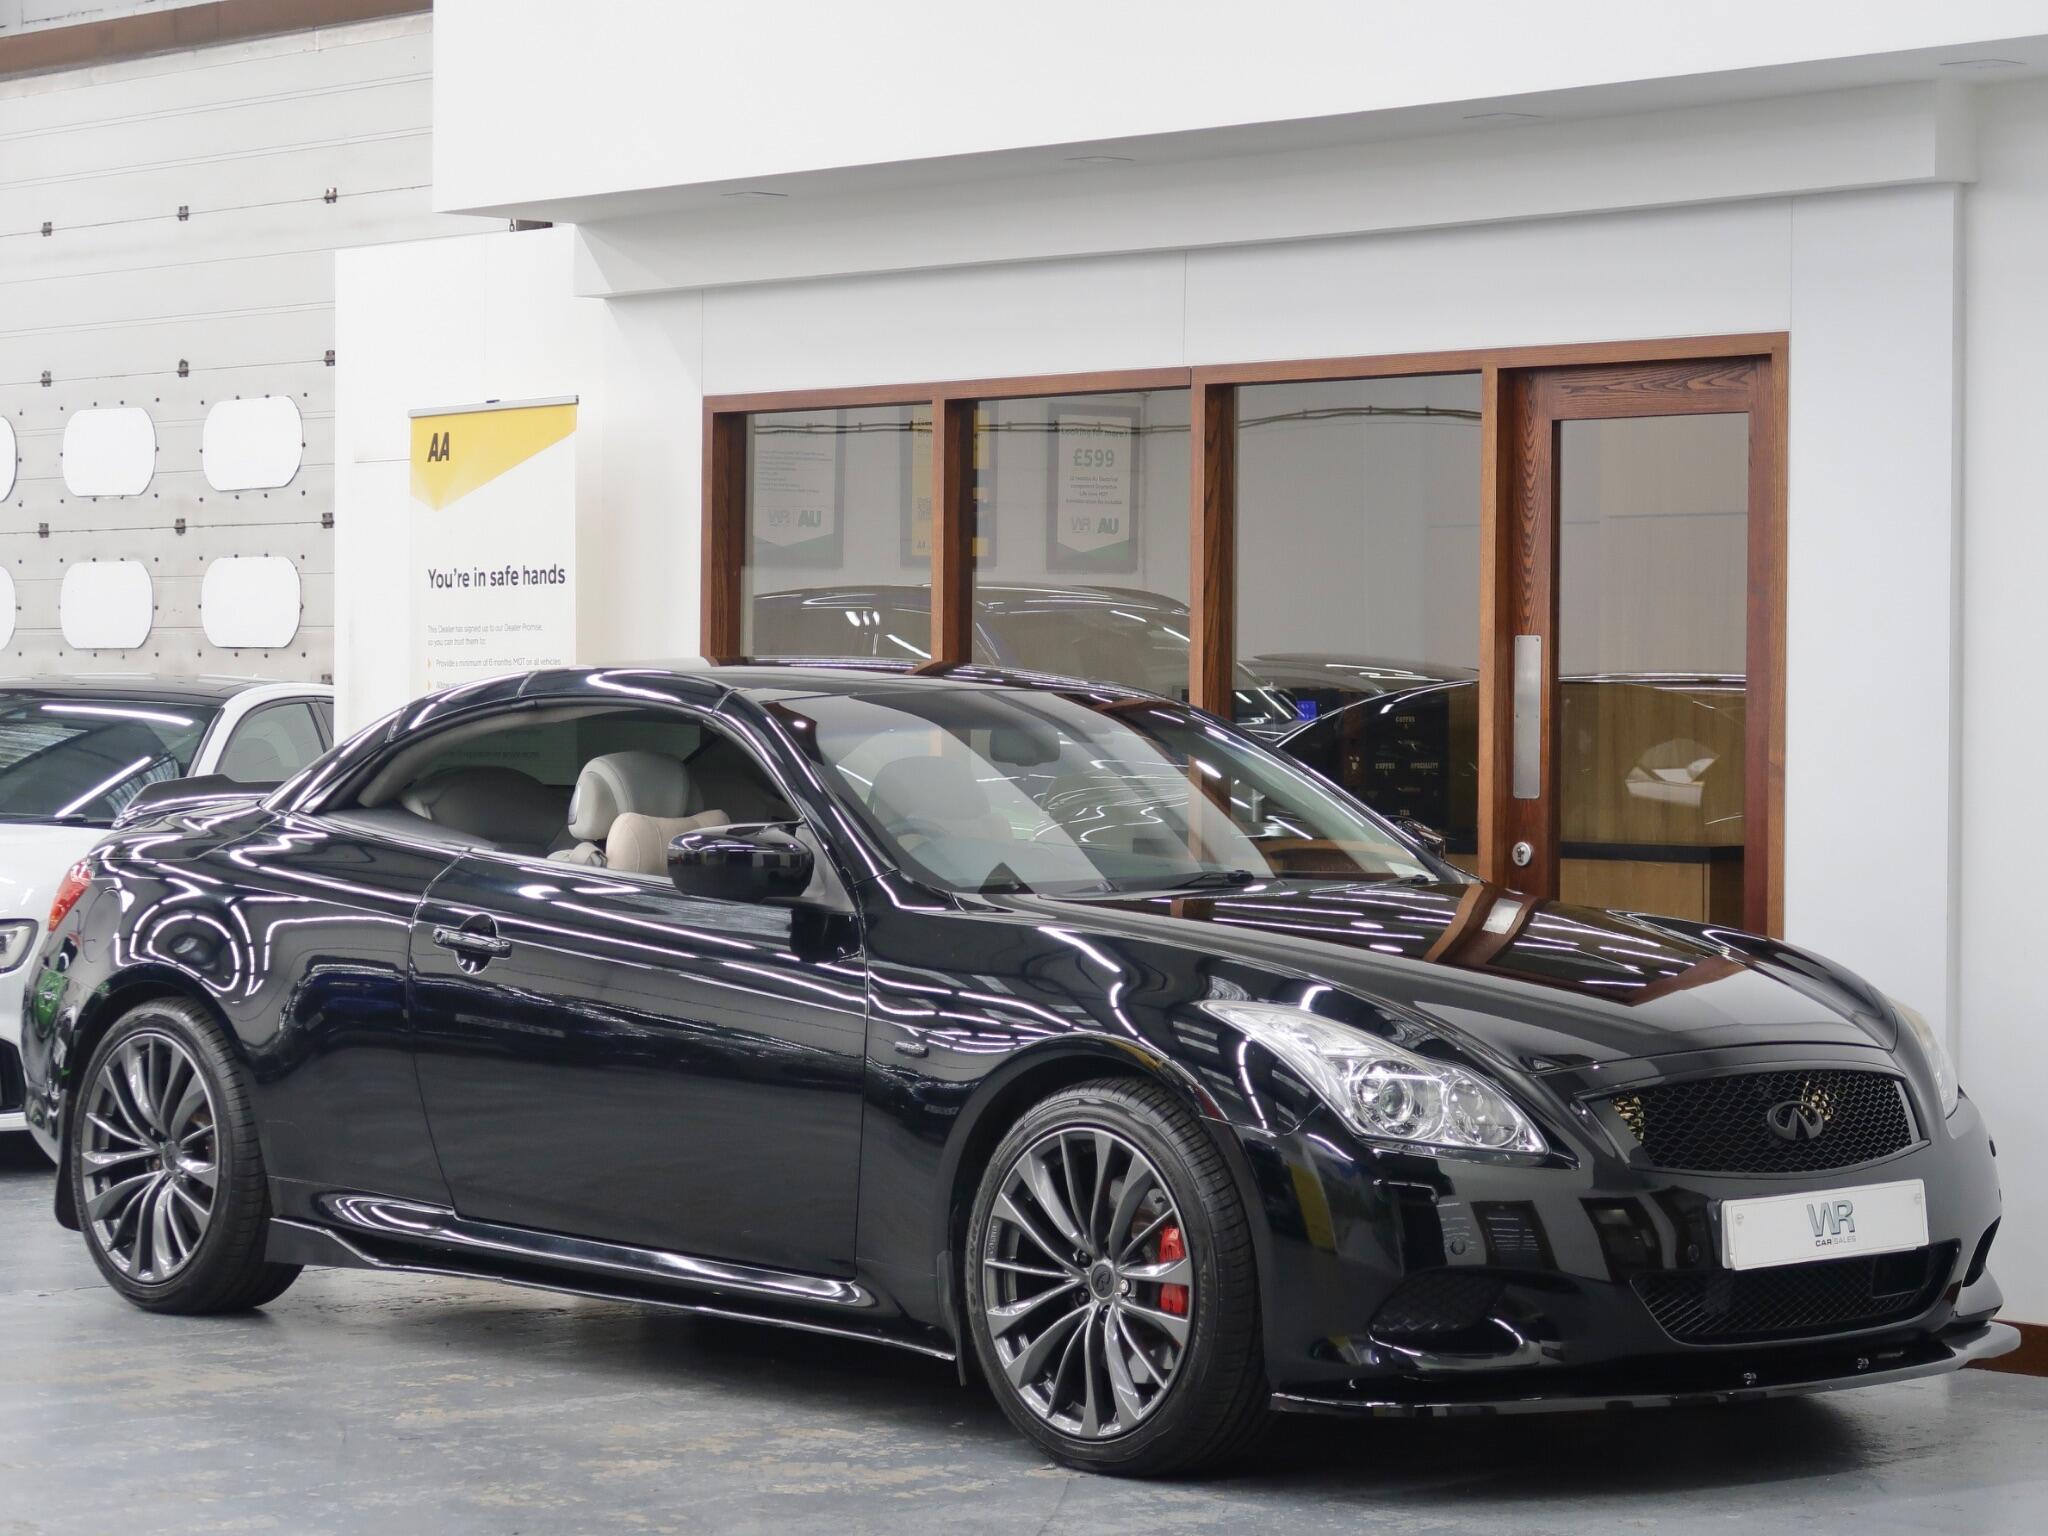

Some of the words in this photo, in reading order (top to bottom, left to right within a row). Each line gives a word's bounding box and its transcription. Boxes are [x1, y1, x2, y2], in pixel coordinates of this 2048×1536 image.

[427, 431, 450, 462] AA
[1073, 448, 1114, 468] £599
[428, 567, 469, 589] You're
[474, 567, 486, 587] in
[490, 565, 519, 587] safe
[523, 564, 566, 586] hands
[1806, 1199, 1856, 1238] WR
[1815, 1238, 1832, 1247] CAR
[1833, 1235, 1857, 1245] SALES
